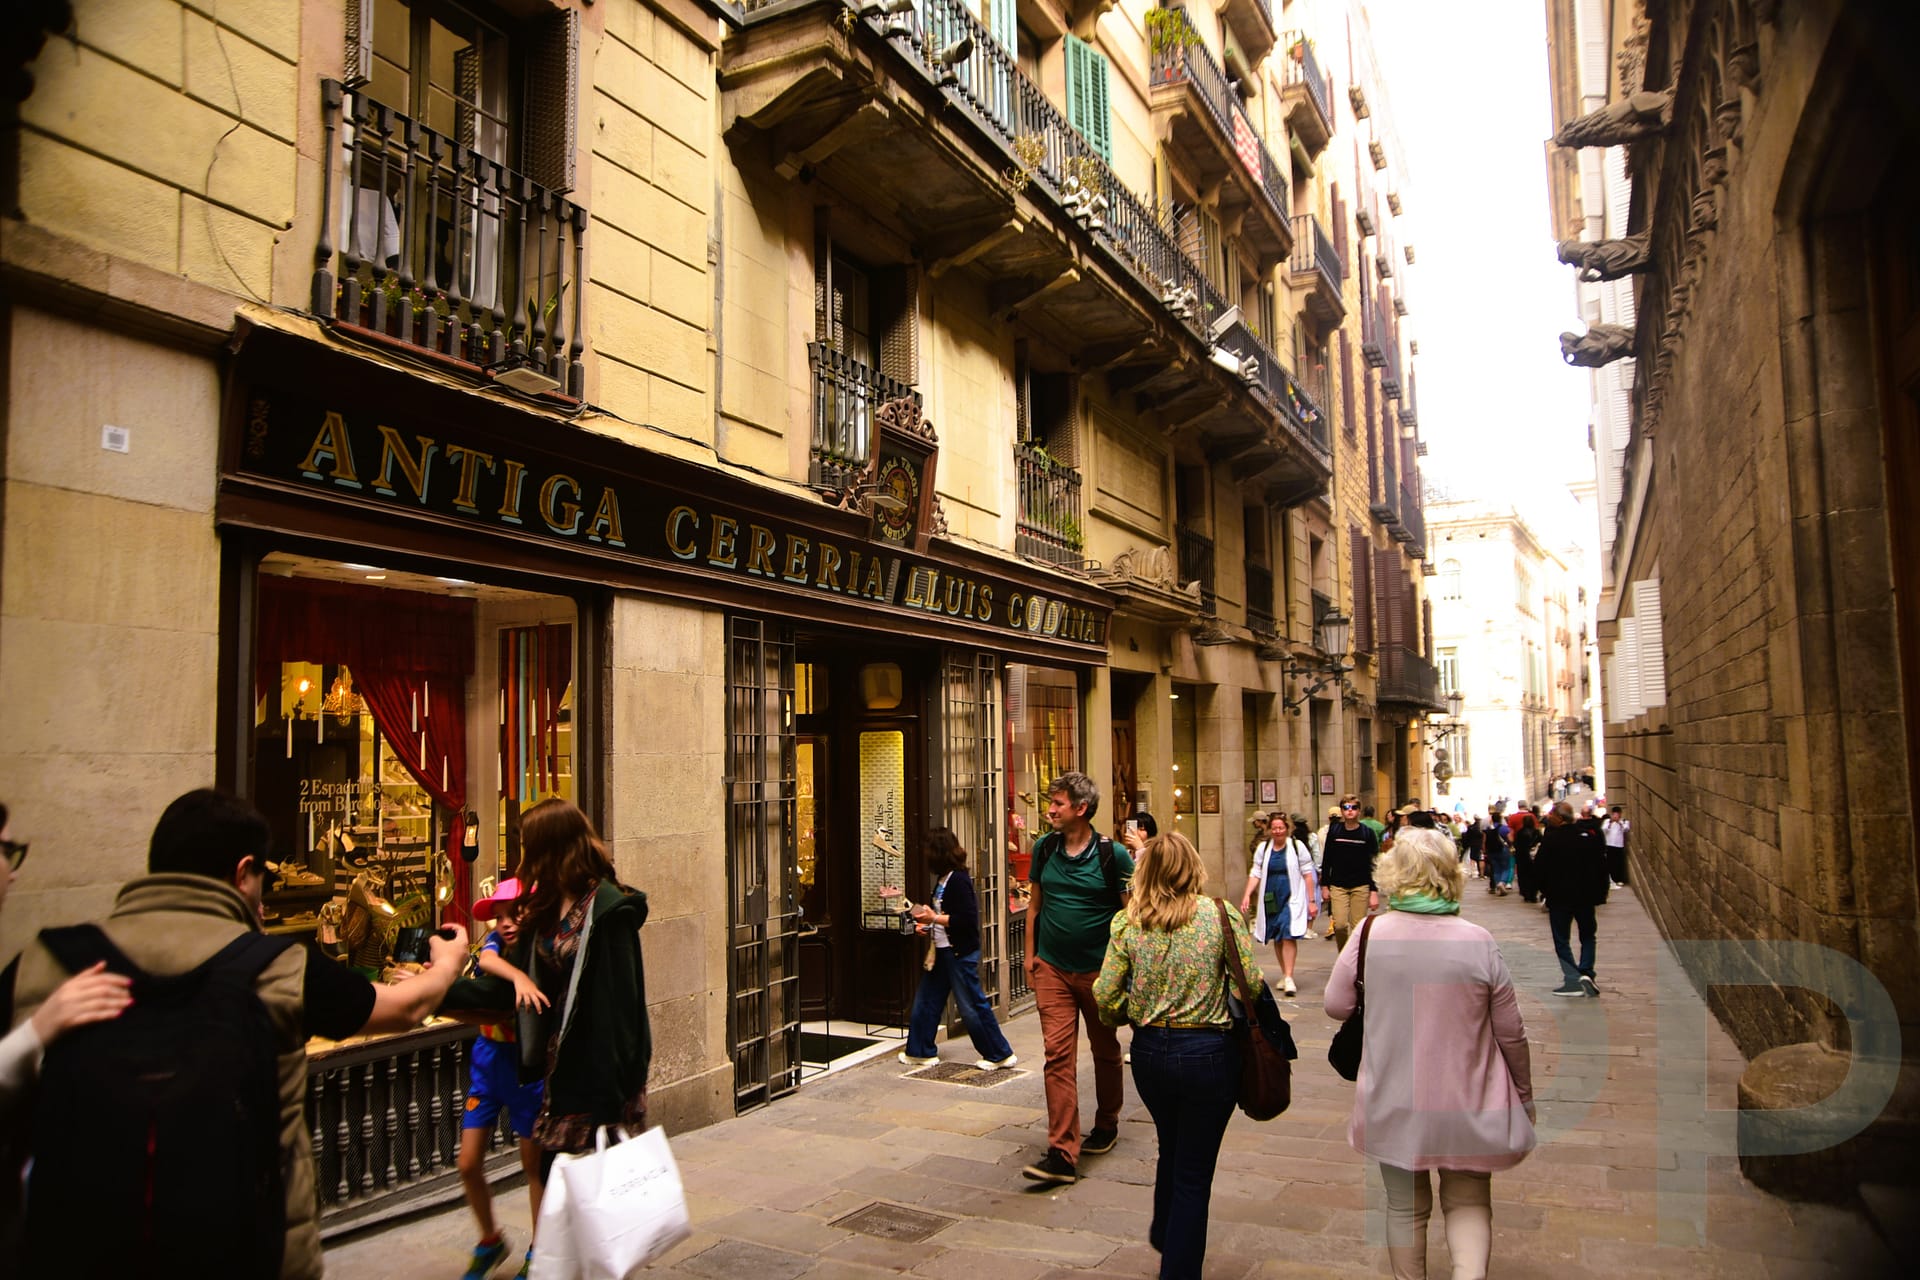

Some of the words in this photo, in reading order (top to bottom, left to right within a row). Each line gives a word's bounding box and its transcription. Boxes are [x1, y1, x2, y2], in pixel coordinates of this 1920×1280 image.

[297, 410, 626, 547] ANTIGA
[665, 505, 887, 601] CERERIA
[905, 566, 993, 622] LLUIS
[1008, 591, 1096, 642] CODINA
[300, 779, 309, 796] 2
[299, 796, 331, 813] from
